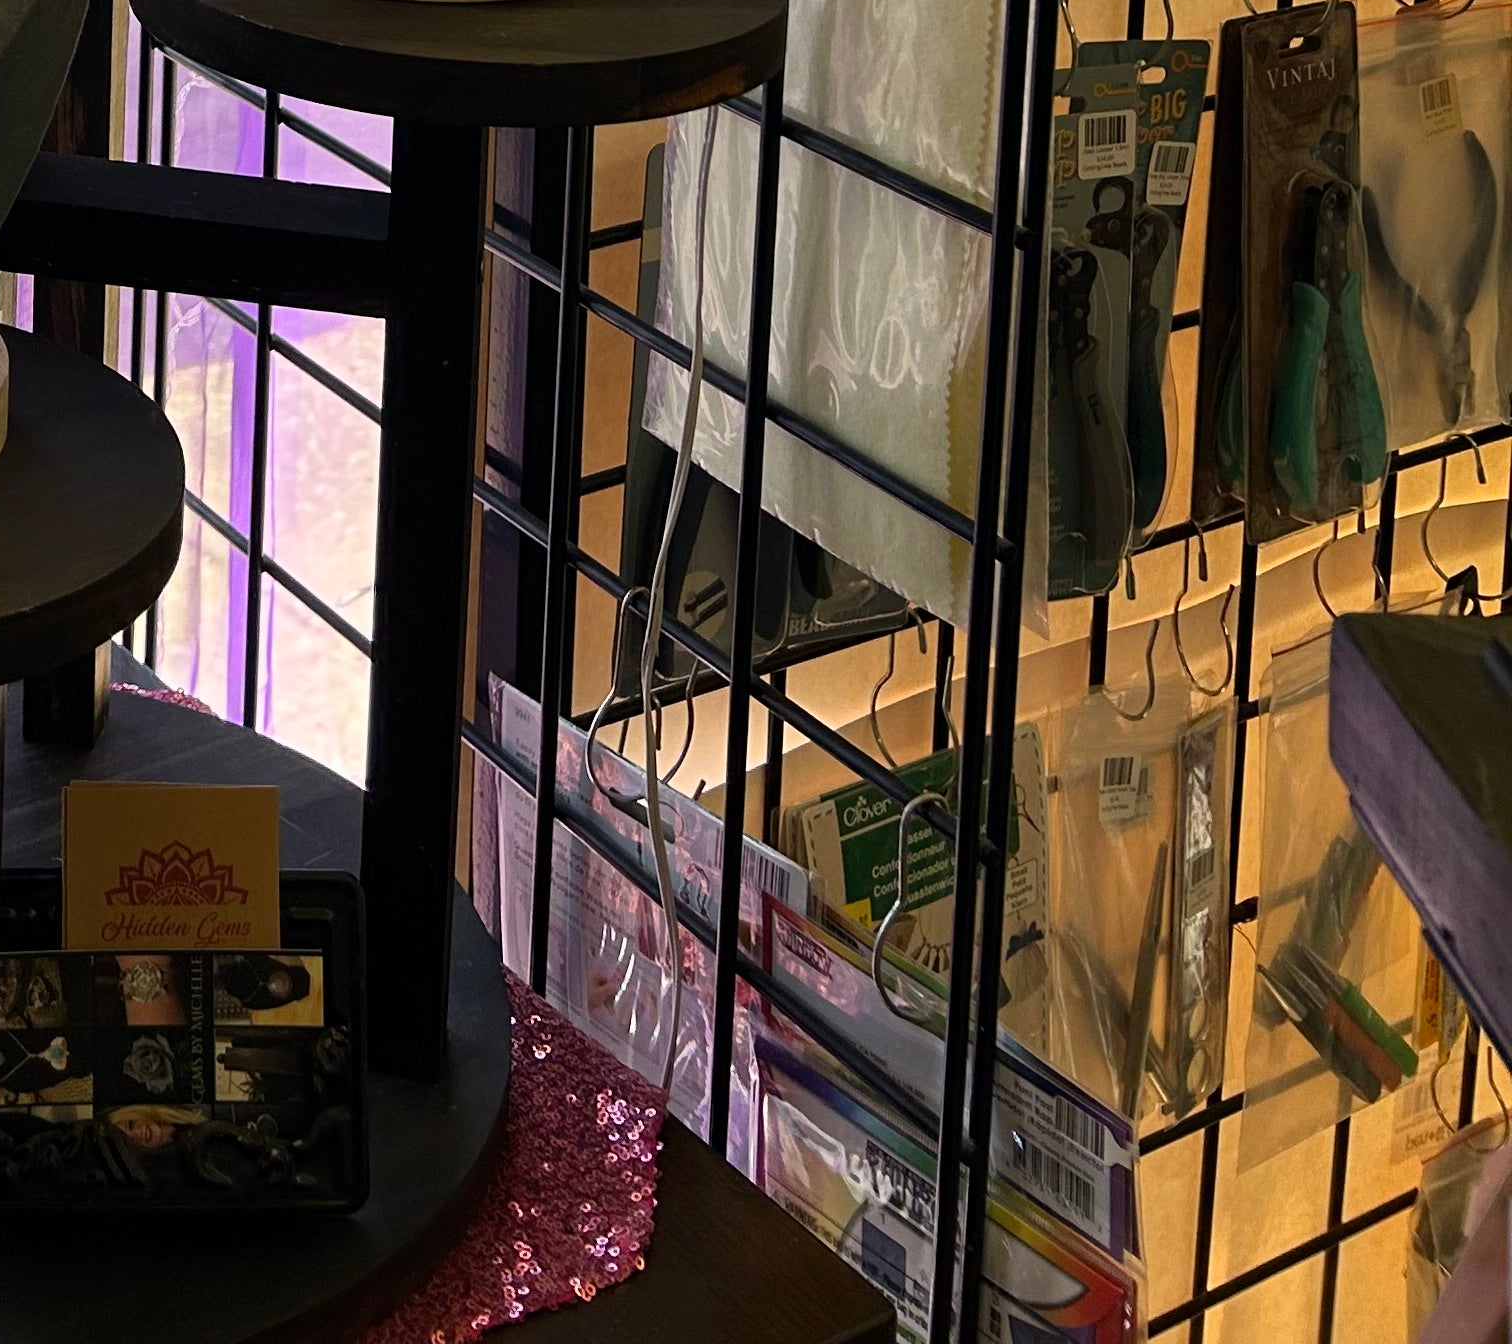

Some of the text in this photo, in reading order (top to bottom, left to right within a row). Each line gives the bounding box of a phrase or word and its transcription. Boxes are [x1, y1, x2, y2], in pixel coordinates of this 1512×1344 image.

[1266, 58, 1337, 90] VINTAJ
[1150, 88, 1188, 125] BIG
[843, 794, 892, 827] Clover
[101, 912, 252, 946] Hidden Gems
